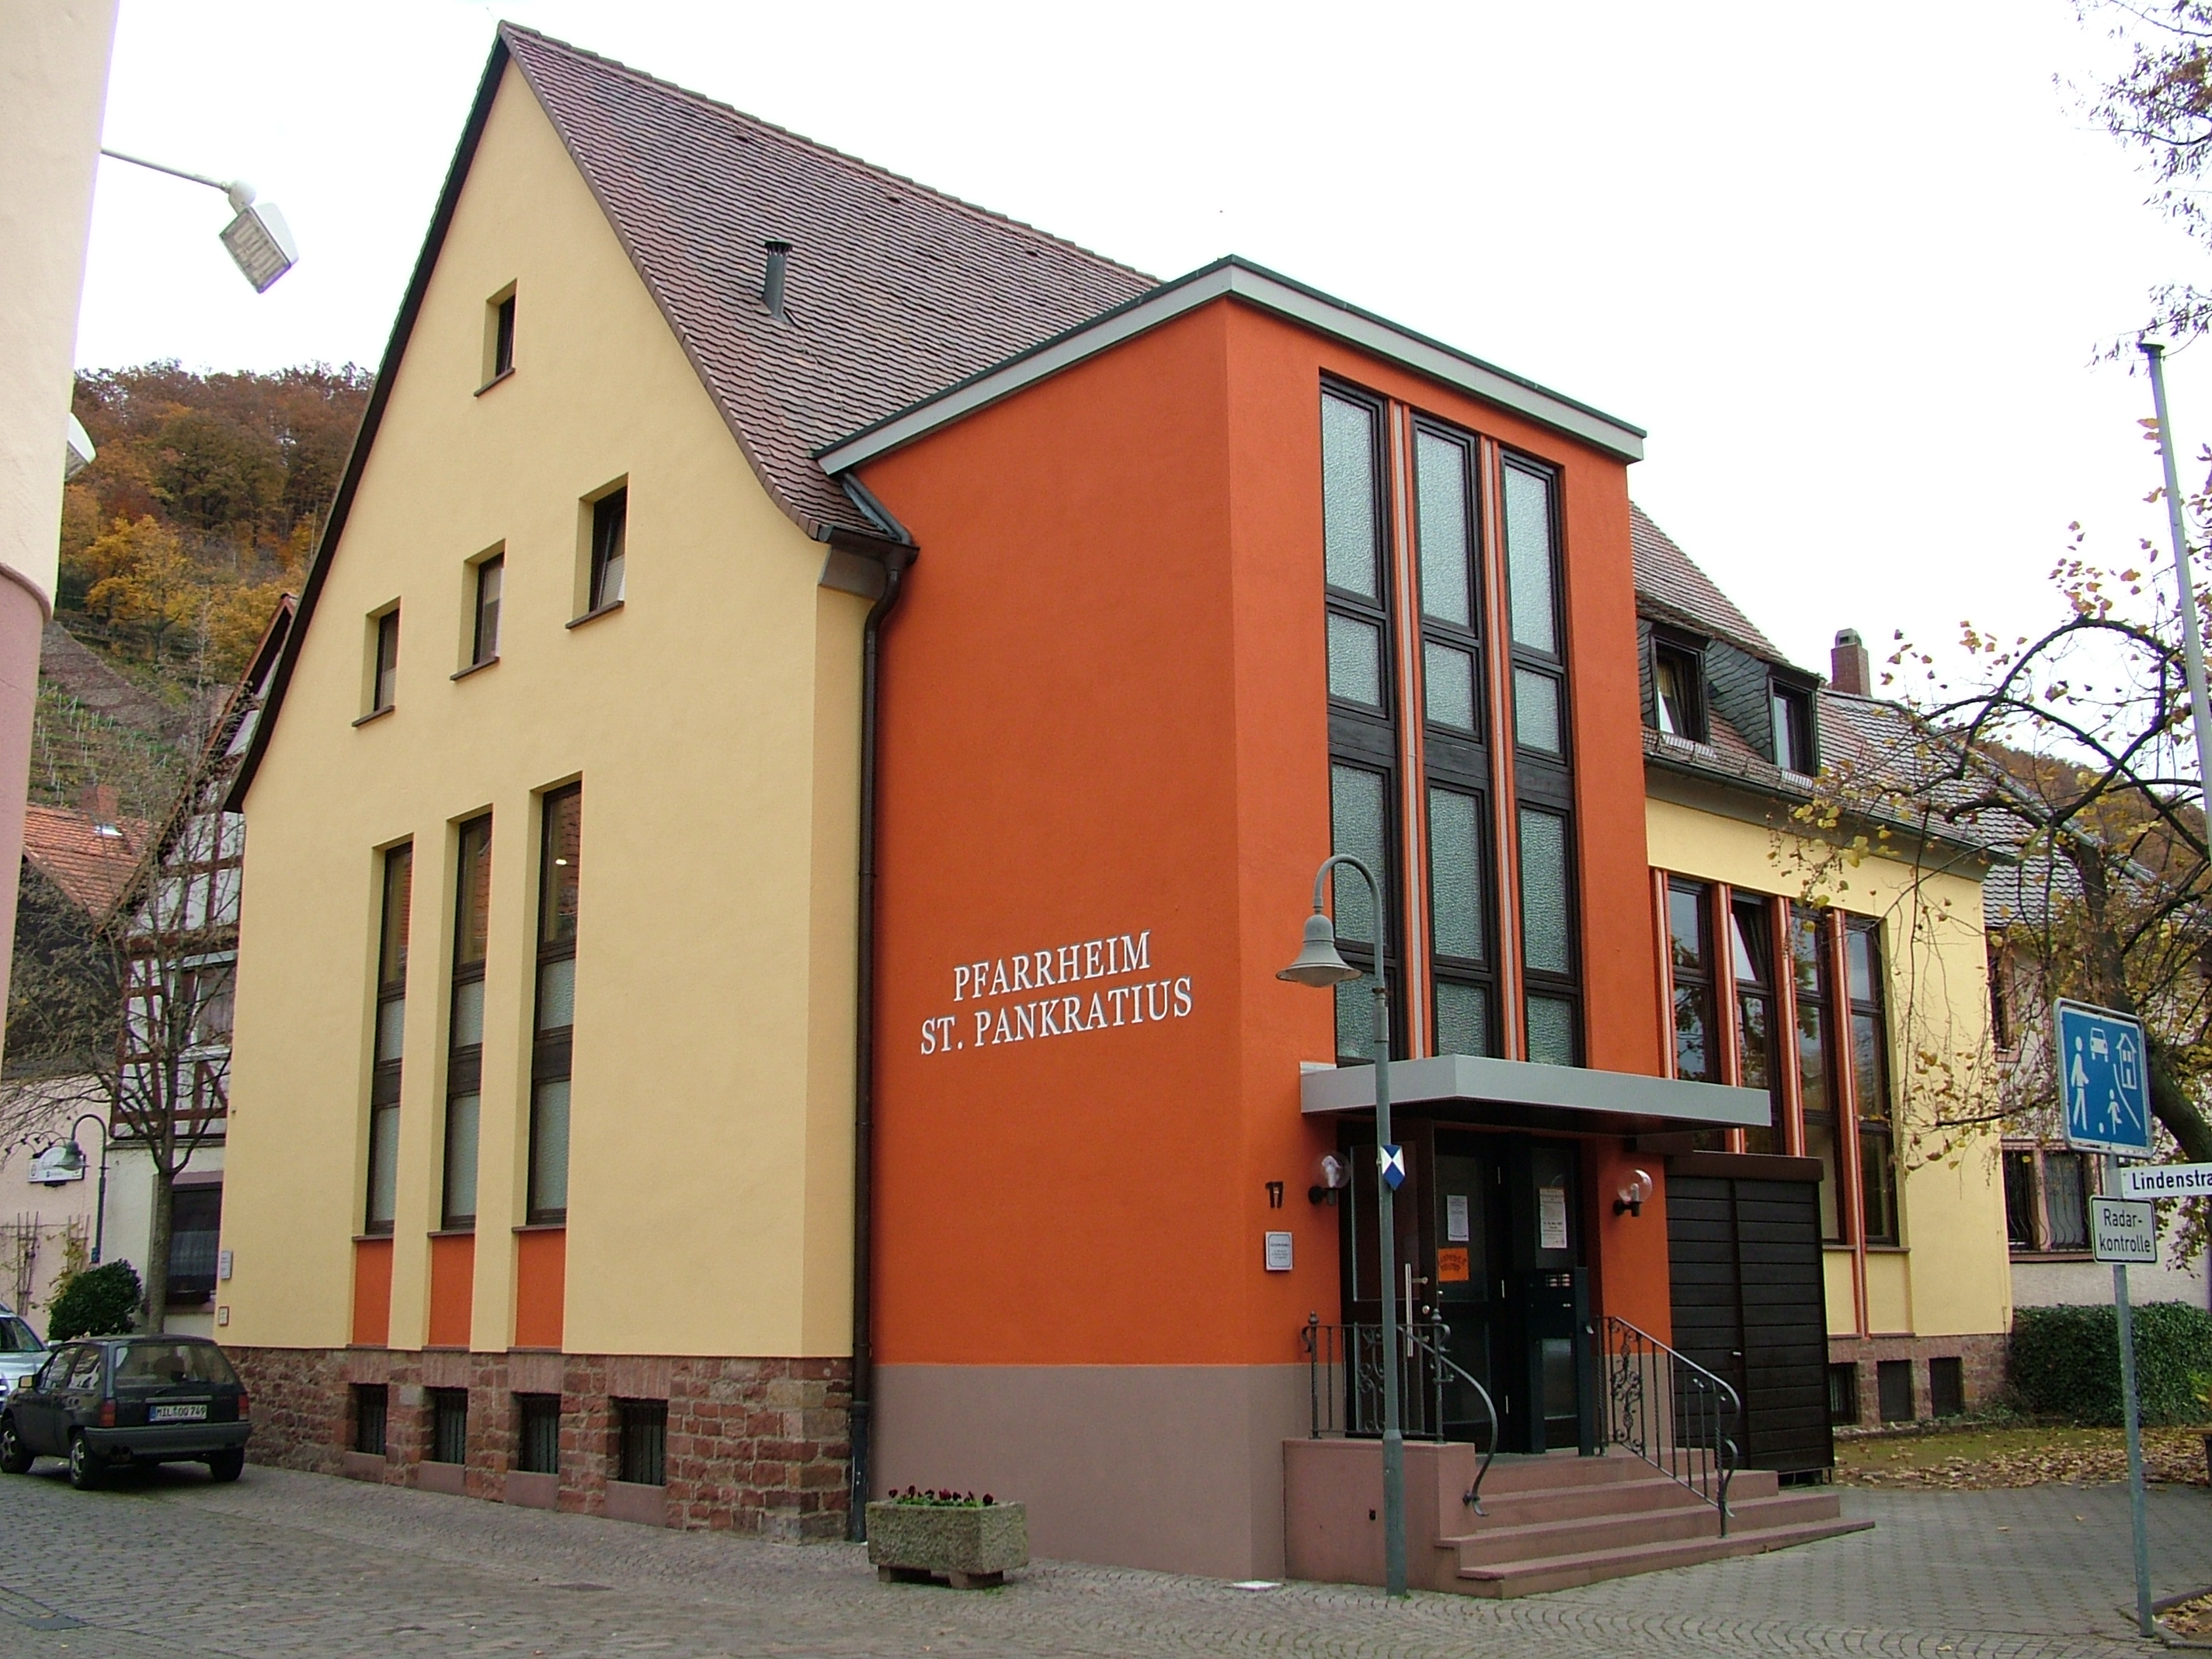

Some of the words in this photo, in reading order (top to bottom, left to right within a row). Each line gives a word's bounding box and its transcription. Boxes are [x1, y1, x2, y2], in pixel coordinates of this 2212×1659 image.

[953, 930, 1151, 1002] PFARRHEIM
[920, 1016, 963, 1055] ST.
[975, 976, 1193, 1047] PANKRATIUS
[1265, 1181, 1284, 1209] 17
[2103, 1208, 2142, 1227] Radar-
[2099, 1233, 2151, 1253] kontrolle
